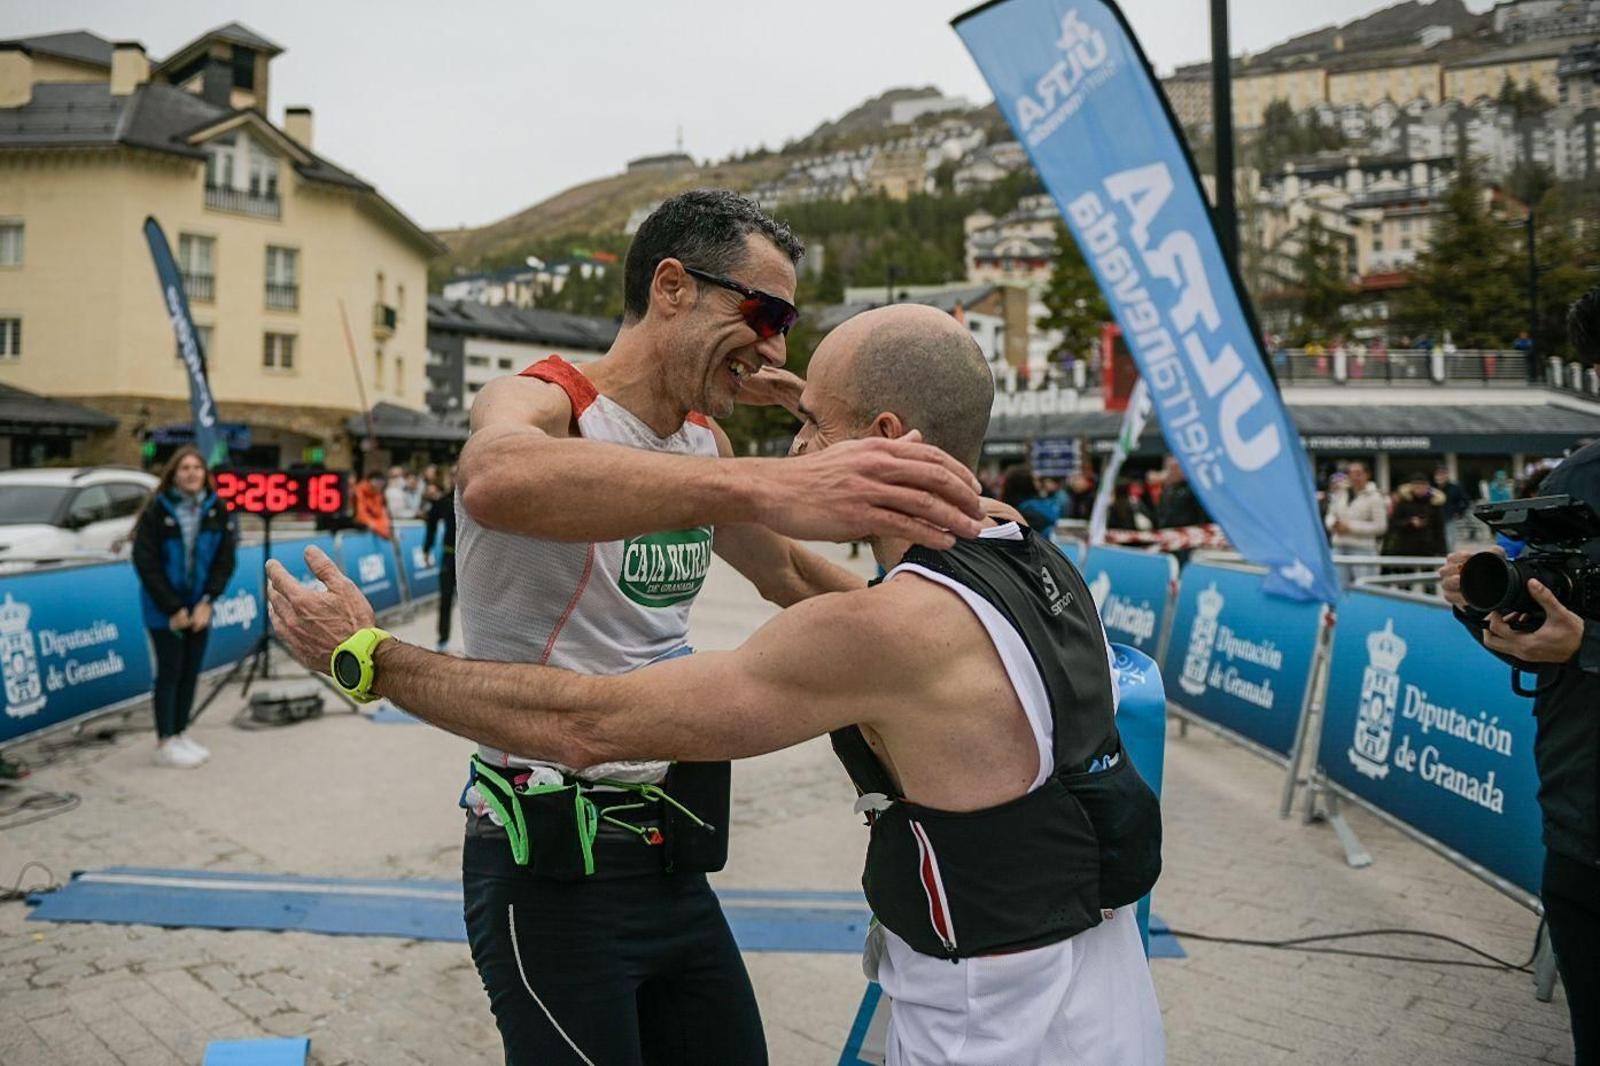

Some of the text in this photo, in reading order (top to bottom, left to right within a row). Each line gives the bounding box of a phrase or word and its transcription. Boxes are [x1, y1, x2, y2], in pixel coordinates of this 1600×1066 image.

[624, 543, 666, 586] CAJA
[38, 620, 119, 657] Diputación
[1104, 593, 1156, 646] Unicaja
[46, 649, 125, 691] de Granada
[1216, 624, 1282, 670] Diputación
[1208, 662, 1275, 710] de Granada
[1402, 683, 1512, 756] Diputación
[1394, 734, 1503, 814] de Granada
